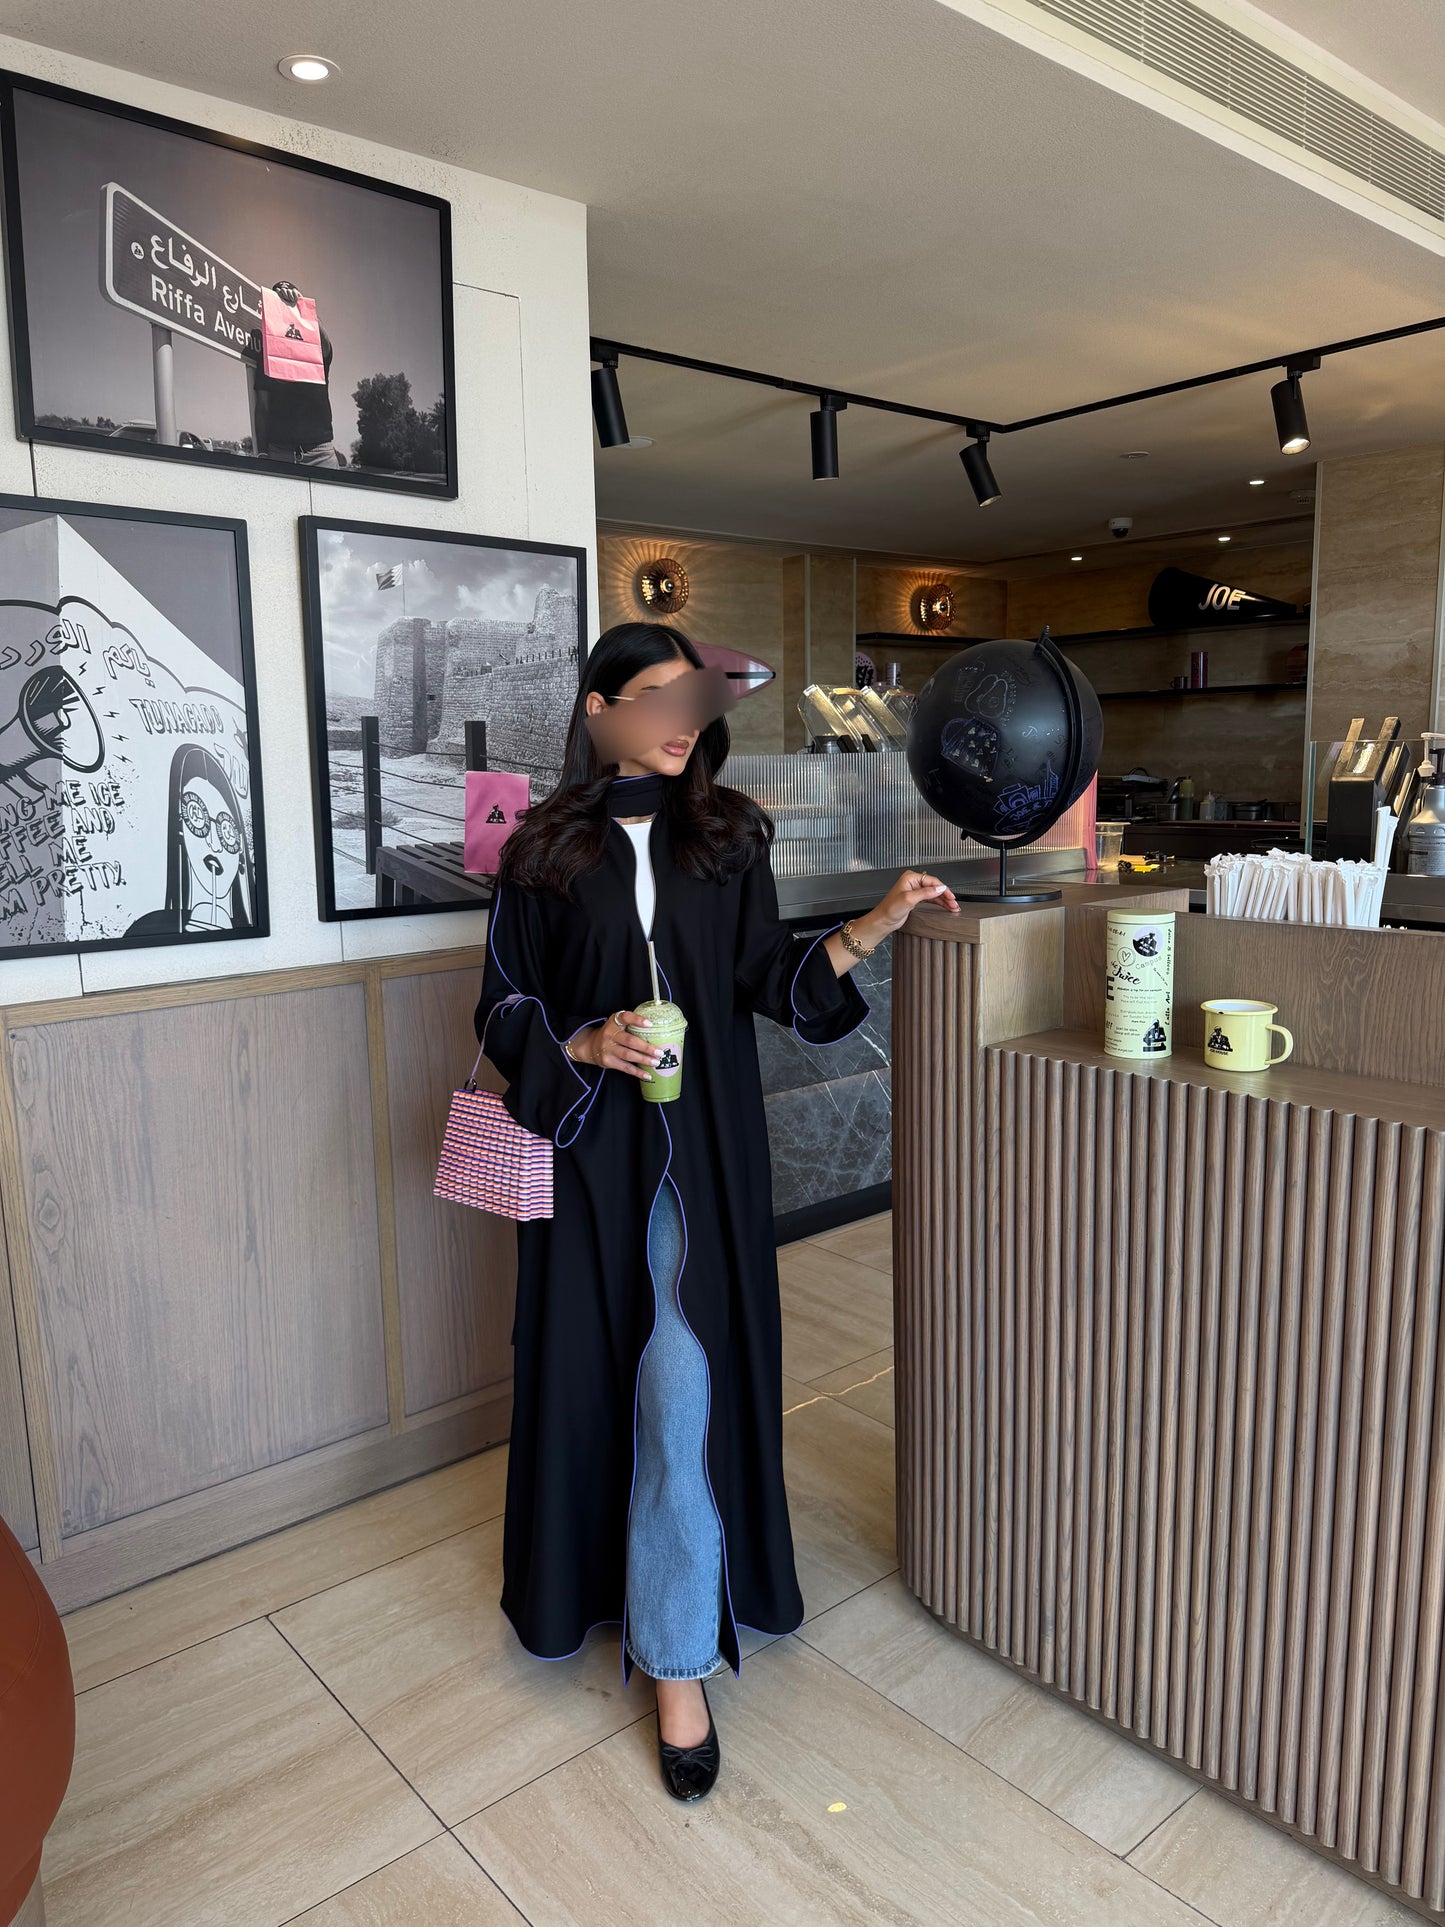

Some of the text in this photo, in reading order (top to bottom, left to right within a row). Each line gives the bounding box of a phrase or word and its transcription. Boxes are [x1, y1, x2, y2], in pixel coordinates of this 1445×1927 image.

[150, 234, 217, 290] الرفاع
[151, 274, 262, 353] Riffa Avenu
[1198, 583, 1246, 611] JOE
[0, 780, 126, 833] NG ME ICE
[0, 806, 116, 860] FFEE AND
[0, 836, 93, 893] ELL ME
[31, 860, 127, 906] PRETTY.
[1112, 965, 1142, 985] Juice
[1135, 955, 1163, 970] Campus
